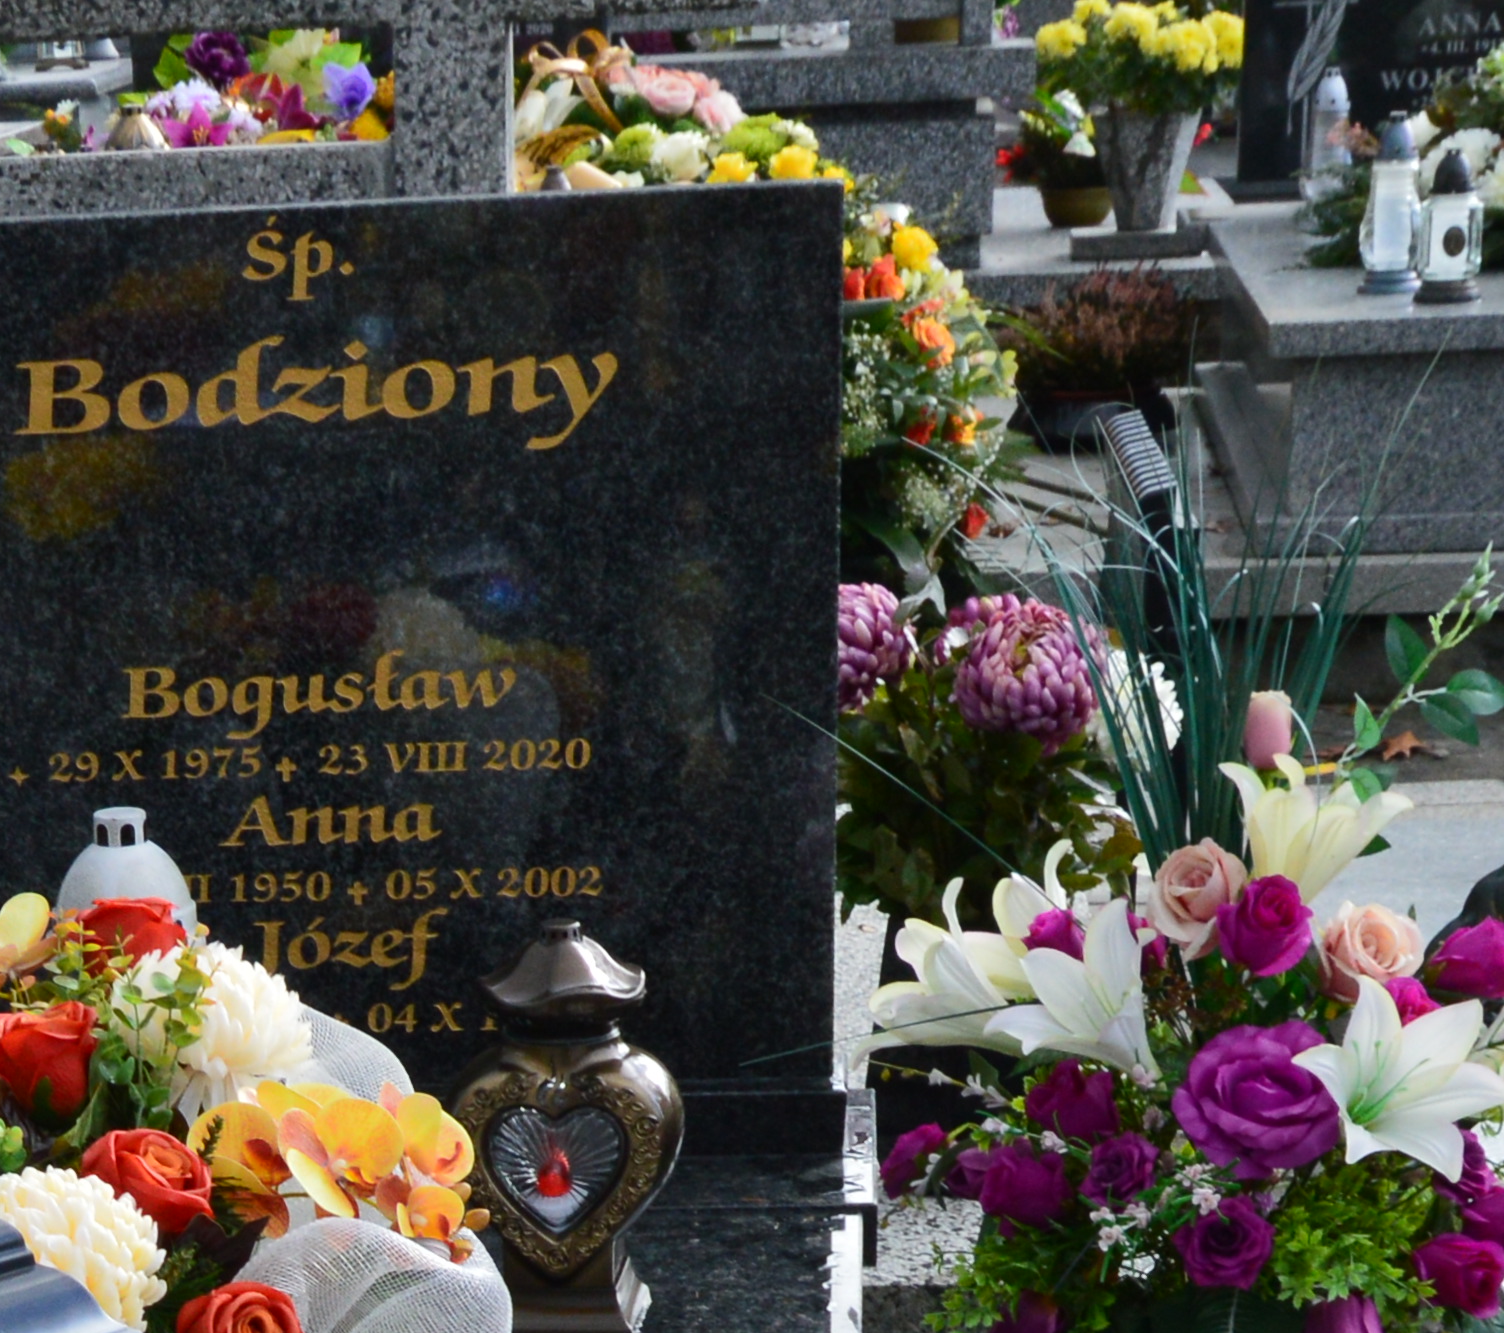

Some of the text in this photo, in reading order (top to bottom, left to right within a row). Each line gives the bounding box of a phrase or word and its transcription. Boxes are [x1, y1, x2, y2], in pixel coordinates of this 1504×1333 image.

[1418, 11, 1502, 37] ANNA
[13, 335, 619, 451] Bodziony
[121, 648, 517, 740] Bogusław
[49, 737, 591, 784] 29 X 1975 23 VIII 2020
[218, 795, 443, 848] Anna
[229, 870, 332, 904] 1950
[385, 868, 438, 900] 05
[450, 867, 483, 900] X
[496, 866, 603, 898] 2002
[252, 907, 450, 991] Józef
[367, 1003, 417, 1034] 04
[429, 1002, 463, 1032] X
